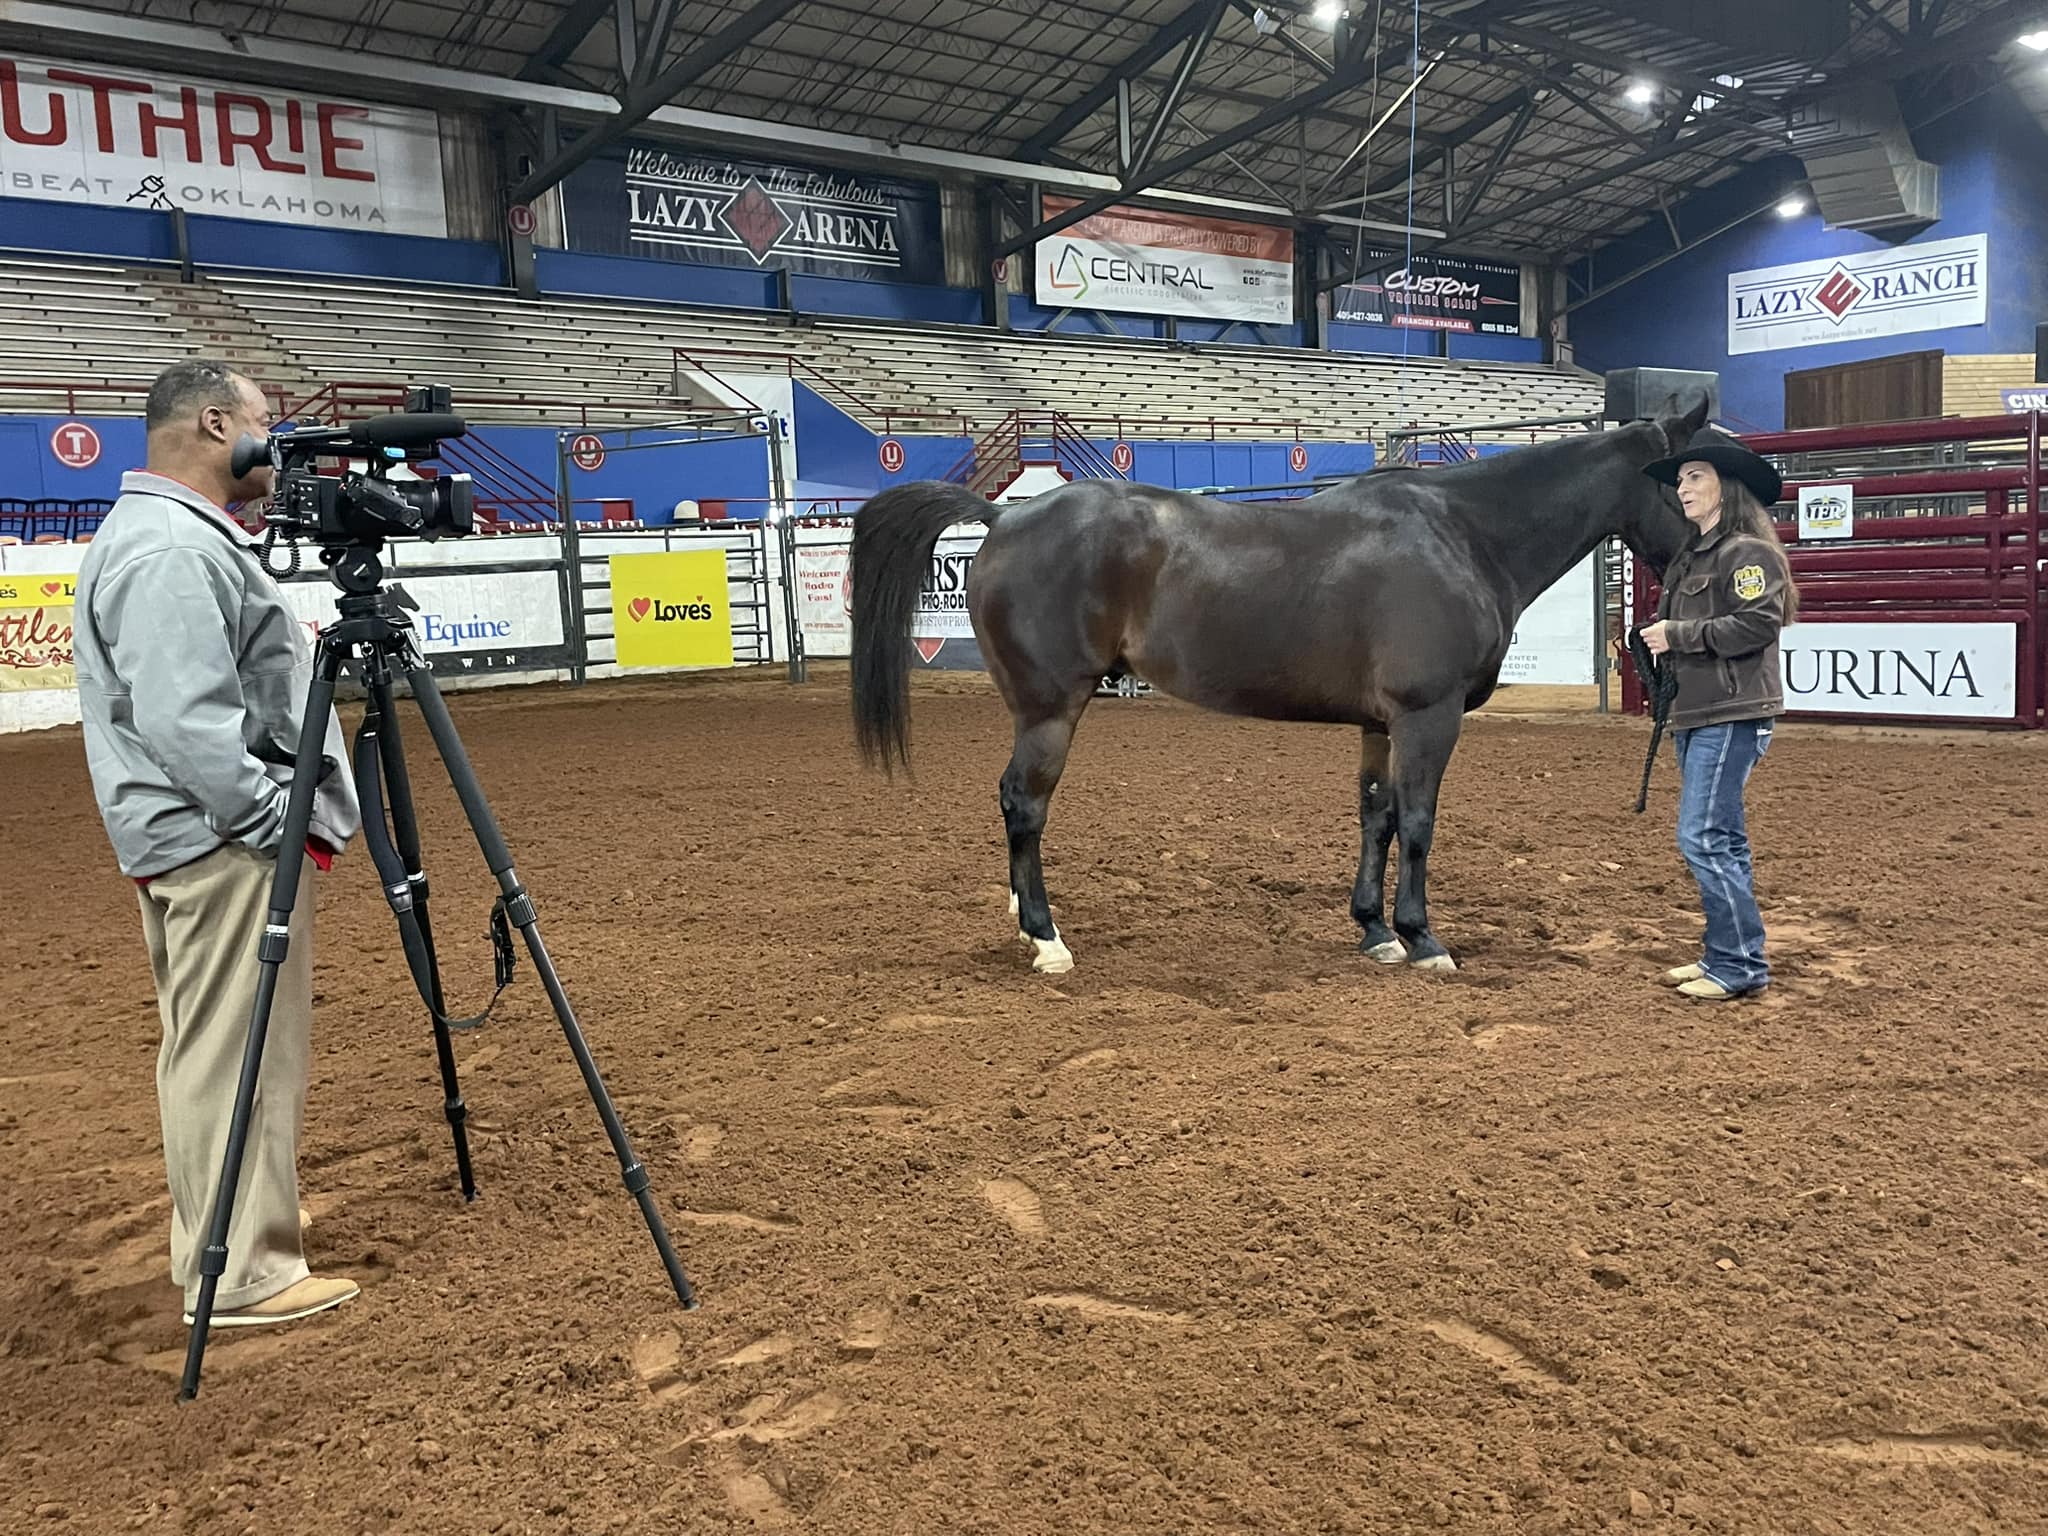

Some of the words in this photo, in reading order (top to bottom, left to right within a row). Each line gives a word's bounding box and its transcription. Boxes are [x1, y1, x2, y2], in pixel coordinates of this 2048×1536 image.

[626, 148, 718, 184] Welcome
[722, 163, 741, 185] to
[768, 168, 799, 192] The
[803, 174, 884, 206] Fabulous
[0, 171, 113, 194] BEAT
[181, 186, 388, 223] OKLAHOMA
[515, 210, 530, 229] U
[627, 189, 721, 232] LAZY
[792, 210, 898, 251] ARENA
[1091, 257, 1214, 290] CENTRAL
[1736, 287, 1808, 319] LAZY
[1872, 262, 1978, 300] RANCH
[1388, 291, 1439, 307] TRAILER
[1444, 297, 1478, 311] SALES
[1397, 316, 1433, 327] FINANCING
[1435, 319, 1469, 330] AVAILABLE
[66, 431, 86, 454] T
[886, 446, 898, 462] U
[1118, 449, 1127, 464] V
[1295, 450, 1303, 464] V
[800, 570, 841, 578] Welcome
[805, 582, 834, 590] Rodeo
[421, 613, 512, 646] Equine
